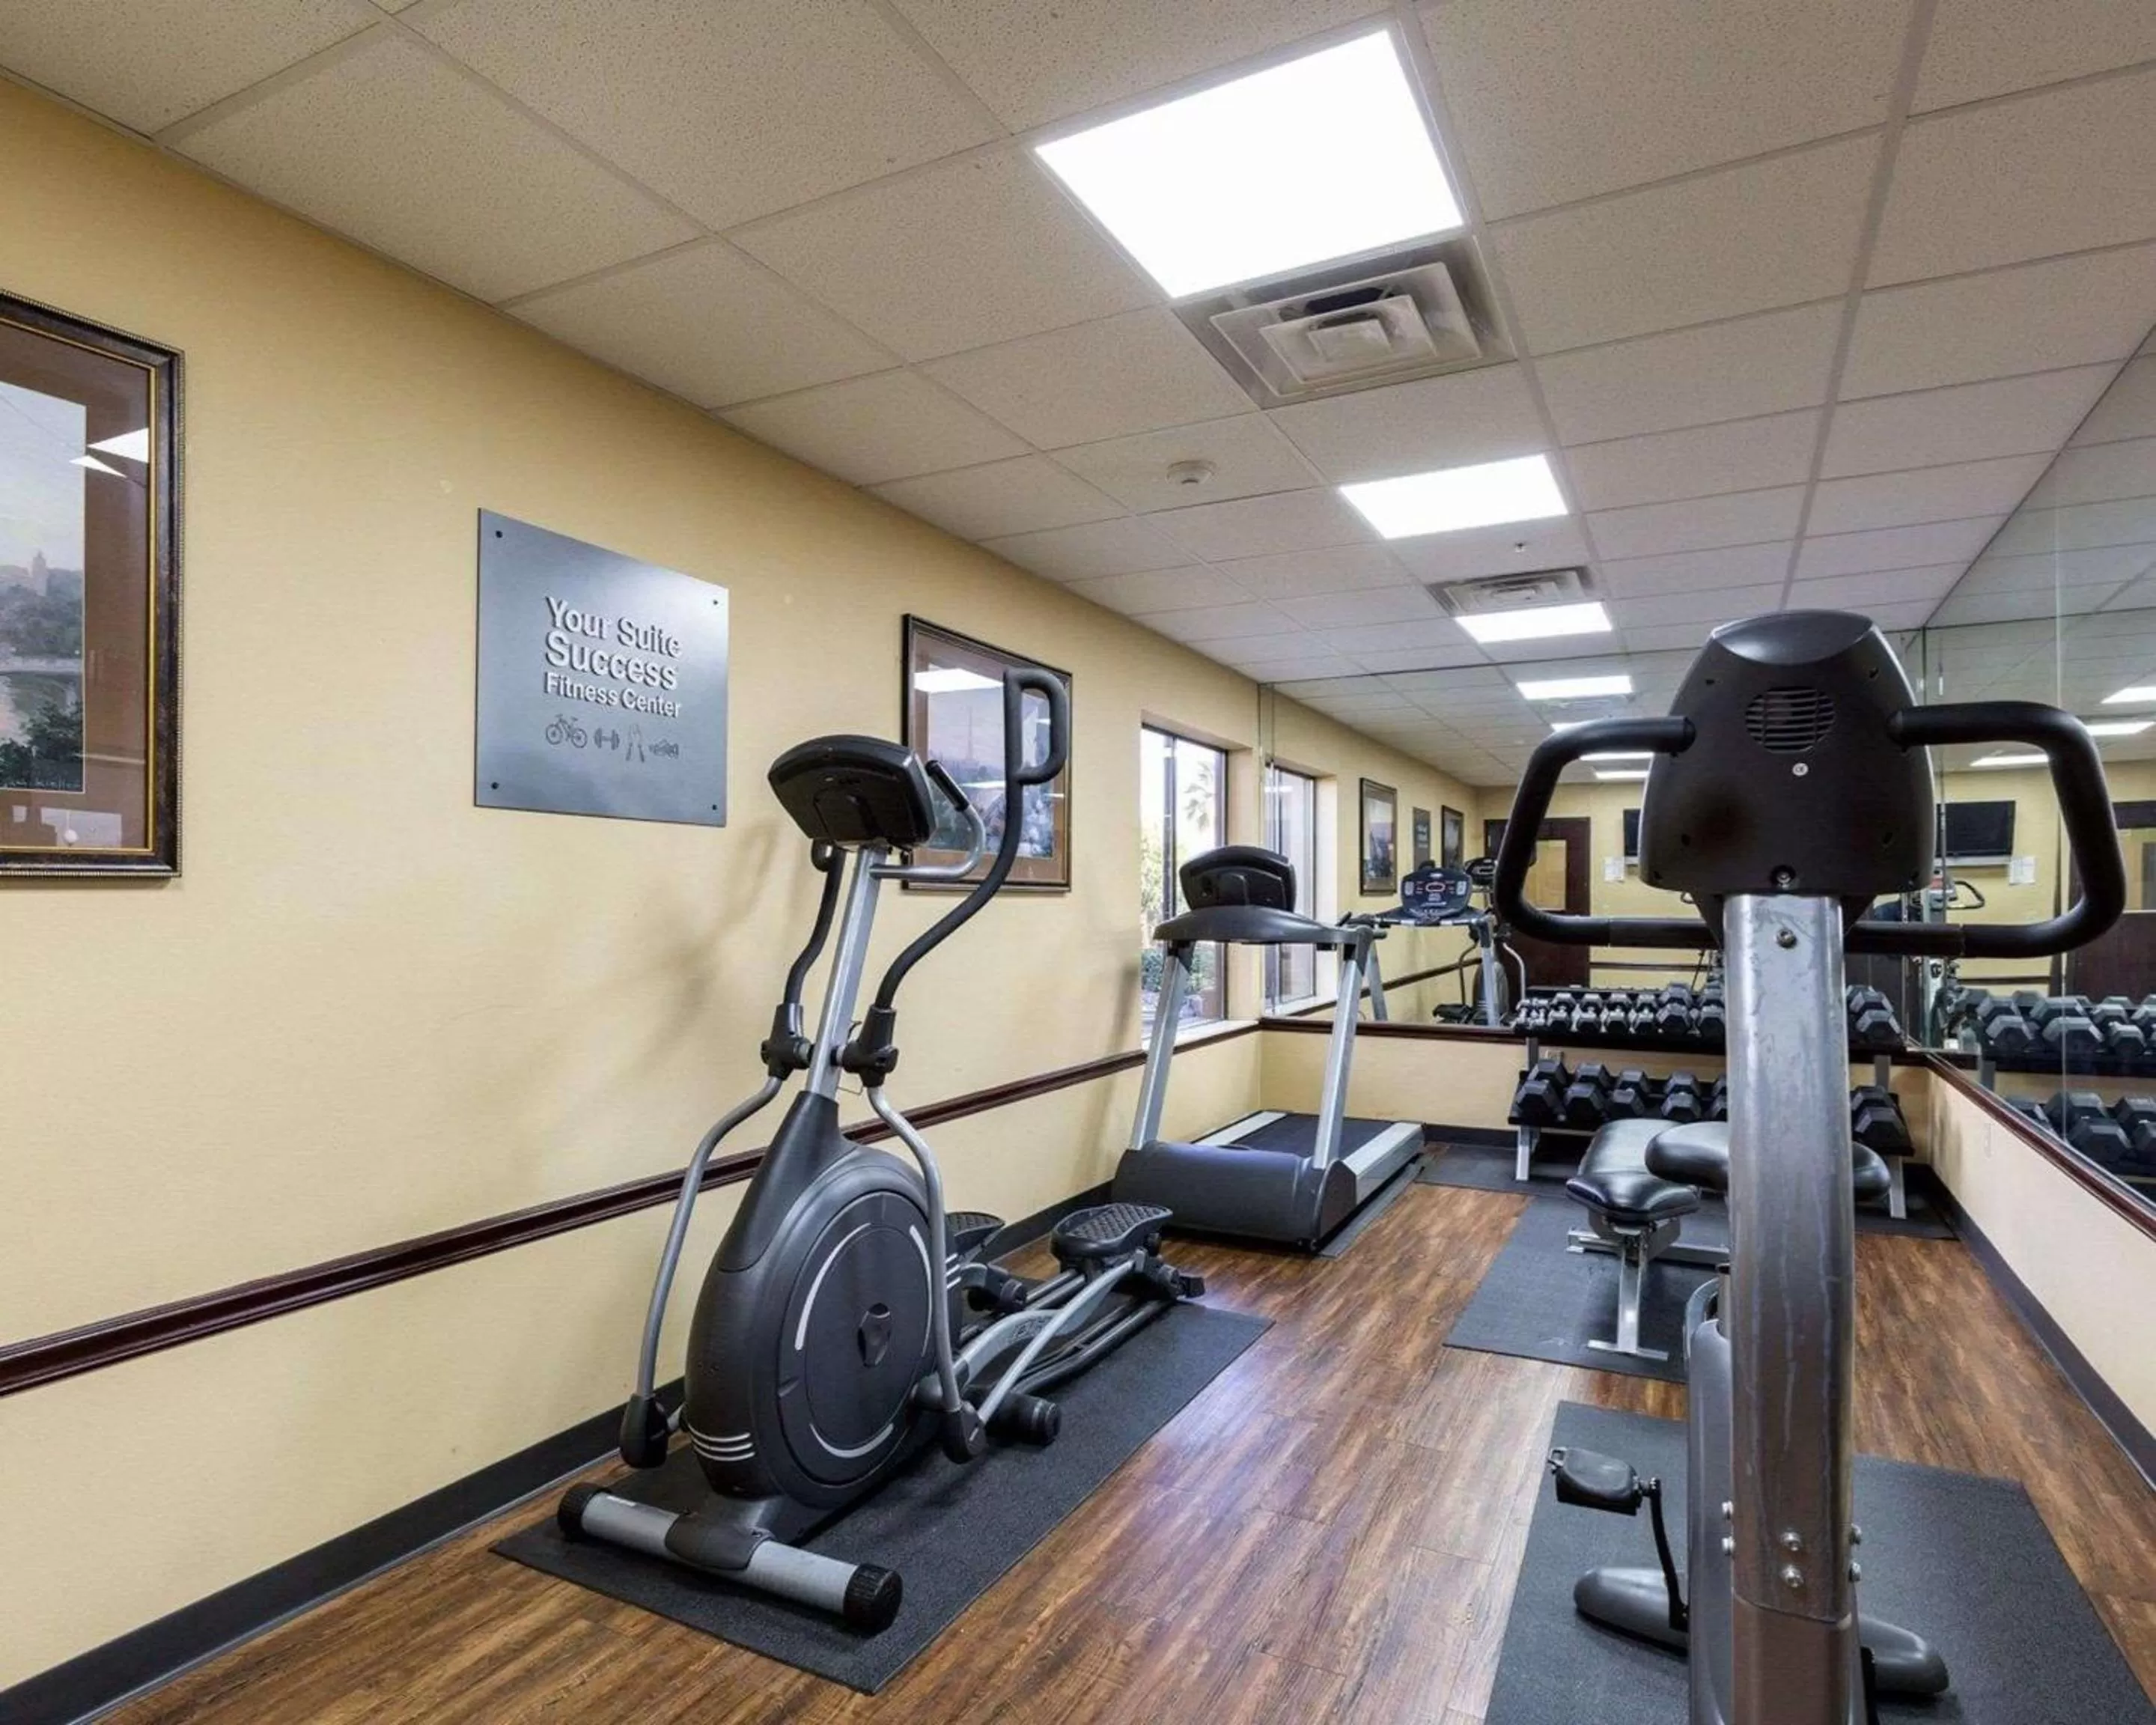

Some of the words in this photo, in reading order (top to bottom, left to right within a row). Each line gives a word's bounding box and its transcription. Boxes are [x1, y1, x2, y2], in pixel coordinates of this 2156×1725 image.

[546, 597, 610, 639] Your
[617, 617, 682, 658] Suite
[546, 630, 677, 690] Success
[545, 672, 619, 705] Fitness
[621, 688, 680, 717] Center
